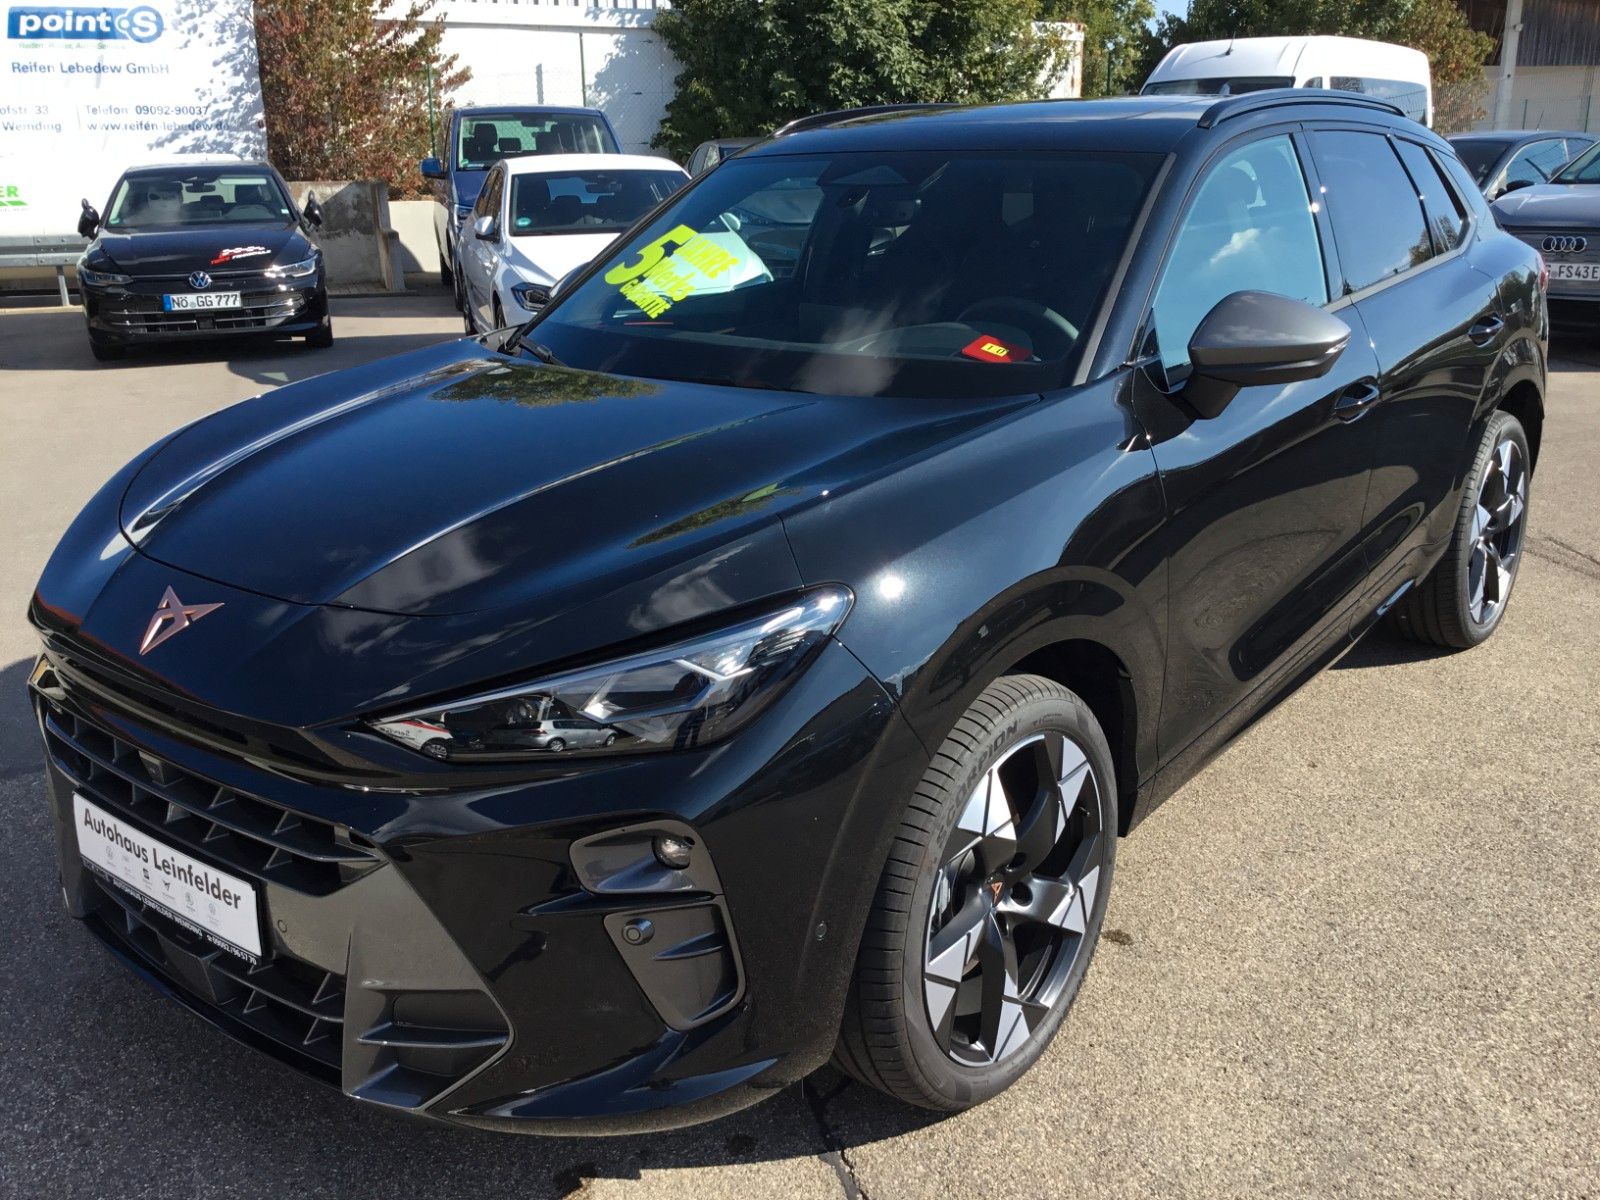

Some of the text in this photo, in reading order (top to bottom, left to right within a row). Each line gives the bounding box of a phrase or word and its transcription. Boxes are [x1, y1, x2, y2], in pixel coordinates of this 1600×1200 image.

[19, 10, 158, 38] point S
[11, 62, 170, 74] Reifen Lebedew GmbH
[34, 105, 49, 116] 33
[85, 105, 209, 116] Telefon 09092-90037
[604, 223, 699, 285] 5
[172, 293, 238, 308] NÖ GG 777
[83, 807, 149, 864] Autohaus
[152, 847, 242, 910] Leinfelder
